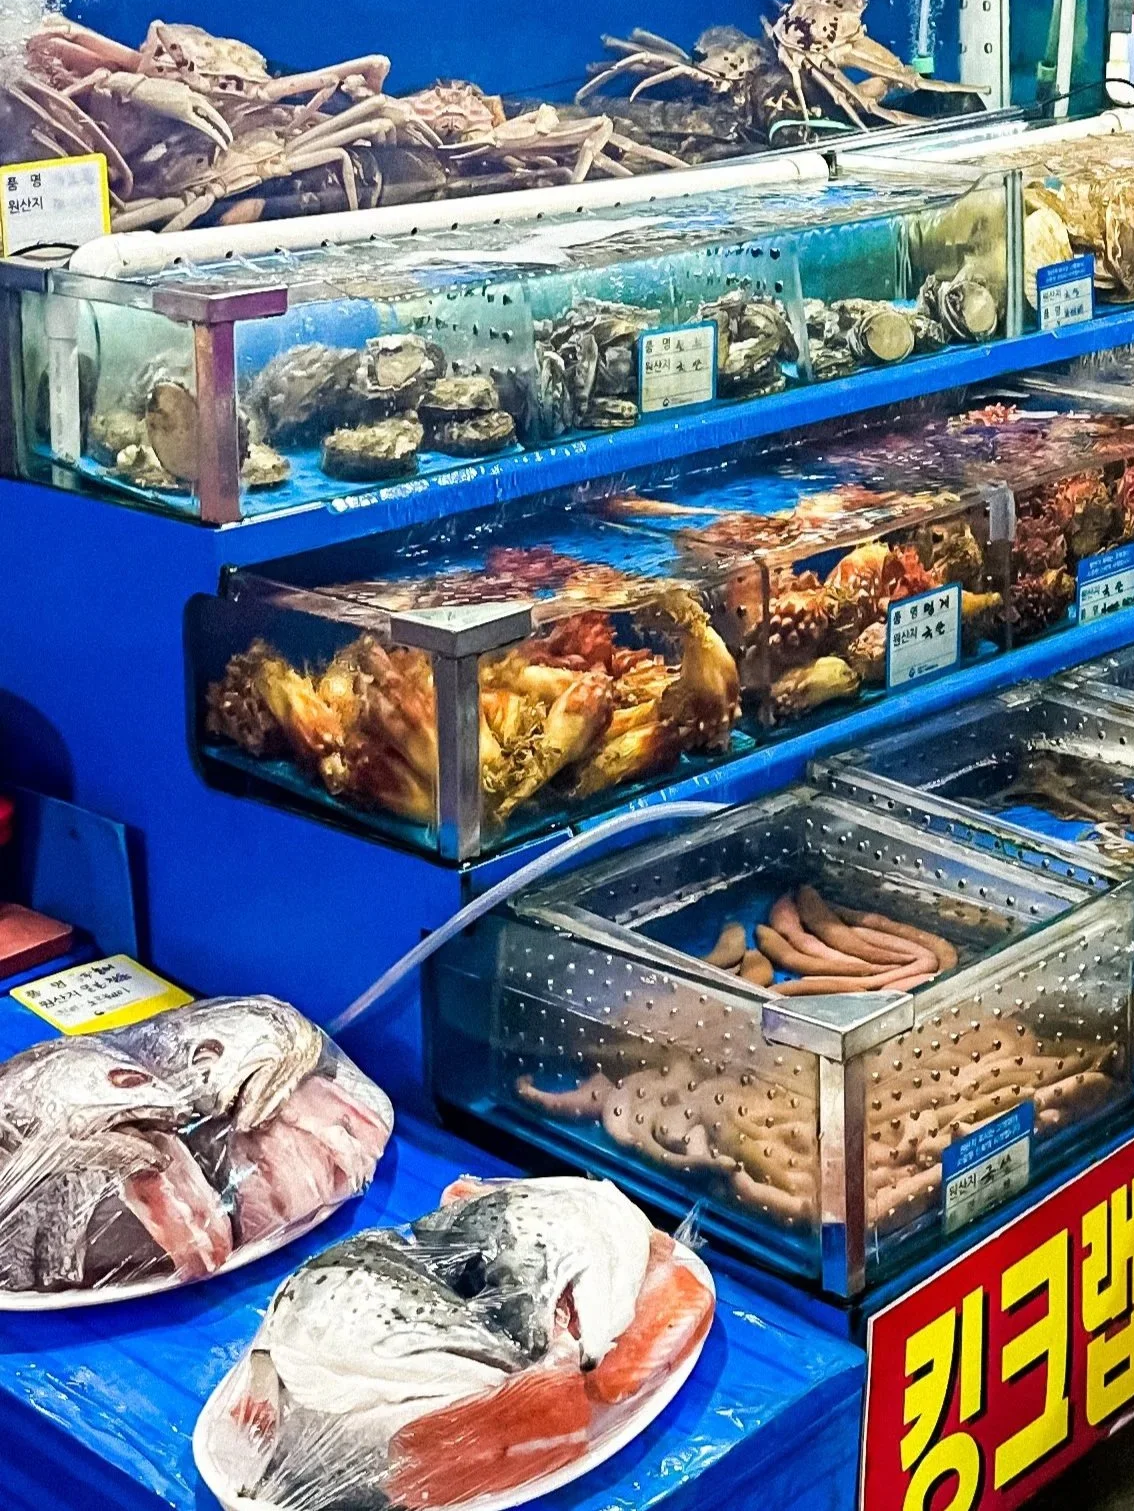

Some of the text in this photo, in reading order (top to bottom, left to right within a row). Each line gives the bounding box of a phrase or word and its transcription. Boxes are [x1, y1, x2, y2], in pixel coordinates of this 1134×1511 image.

[8, 196, 43, 215] 원산지
[645, 358, 671, 375] 원산지
[893, 626, 918, 647] 원산지
[949, 1173, 977, 1201] 원산지
